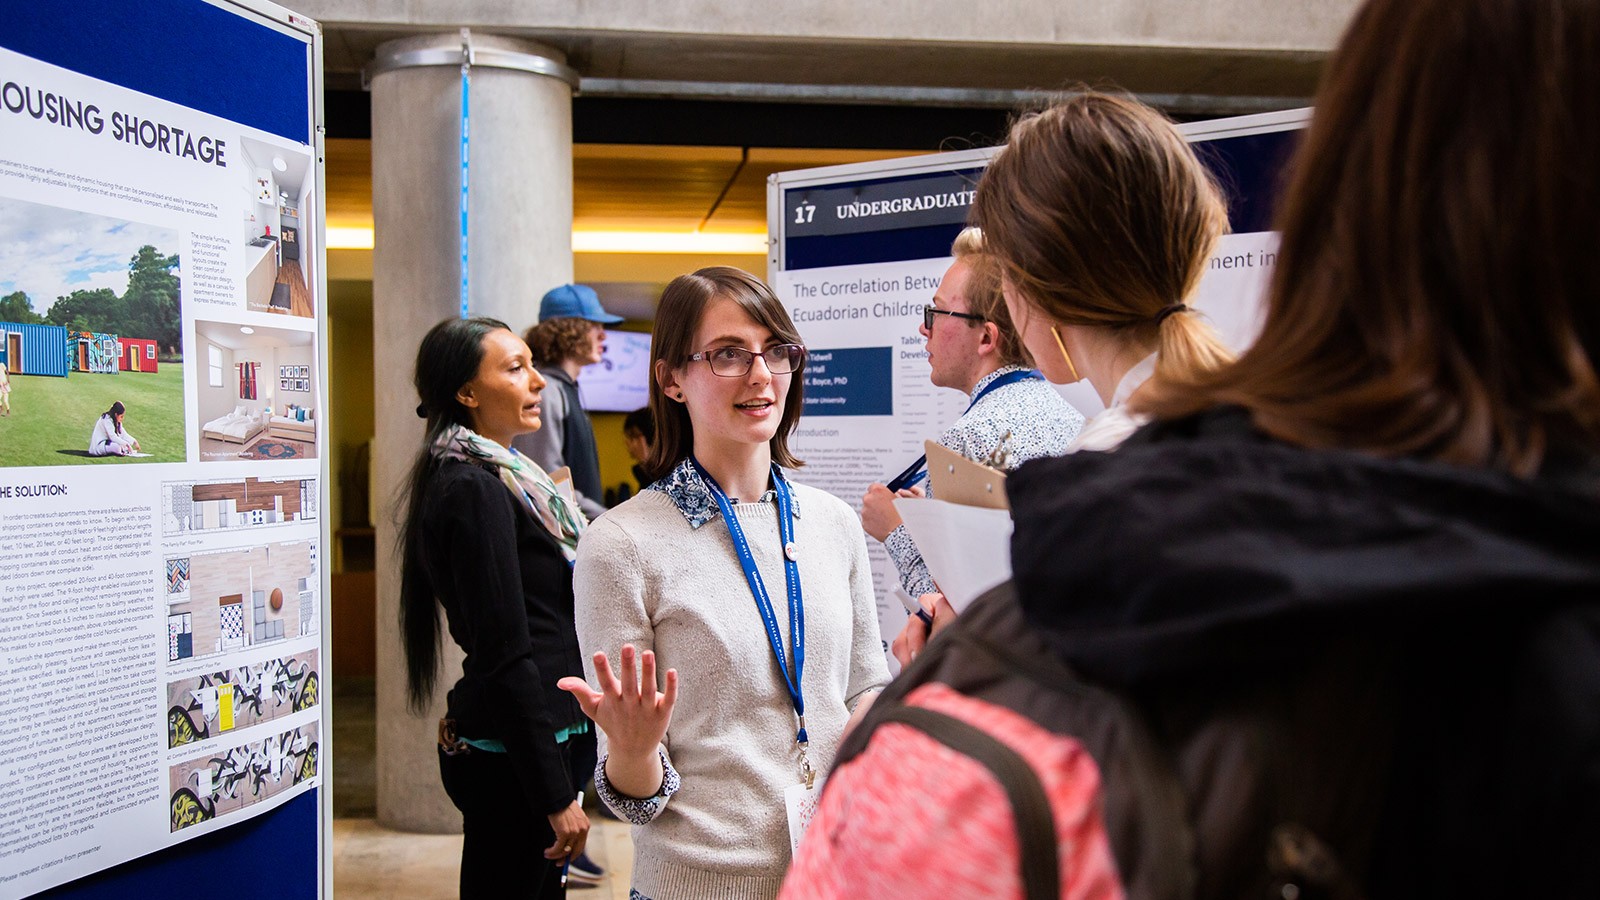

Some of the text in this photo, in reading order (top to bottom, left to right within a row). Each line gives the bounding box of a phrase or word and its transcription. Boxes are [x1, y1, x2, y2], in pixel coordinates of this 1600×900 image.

[0, 82, 226, 167] OUSING SHORTAGE
[0, 158, 21, 169] ntainers
[795, 206, 816, 224] 17
[1209, 250, 1276, 269] ment in
[794, 276, 940, 297] The Correlation Betw
[793, 301, 923, 322] Ecuadorian Childre
[810, 353, 832, 361] Tidwell
[901, 351, 928, 359] Develo
[812, 378, 833, 386] Boyce,
[797, 428, 839, 437] troduction
[0, 484, 68, 498] HE SOLUTION:
[752, 571, 771, 618] UtahStateUniversity
[19, 864, 39, 879] request
[40, 856, 62, 870] citations
[64, 852, 76, 862] from
[77, 843, 101, 860] presenter
